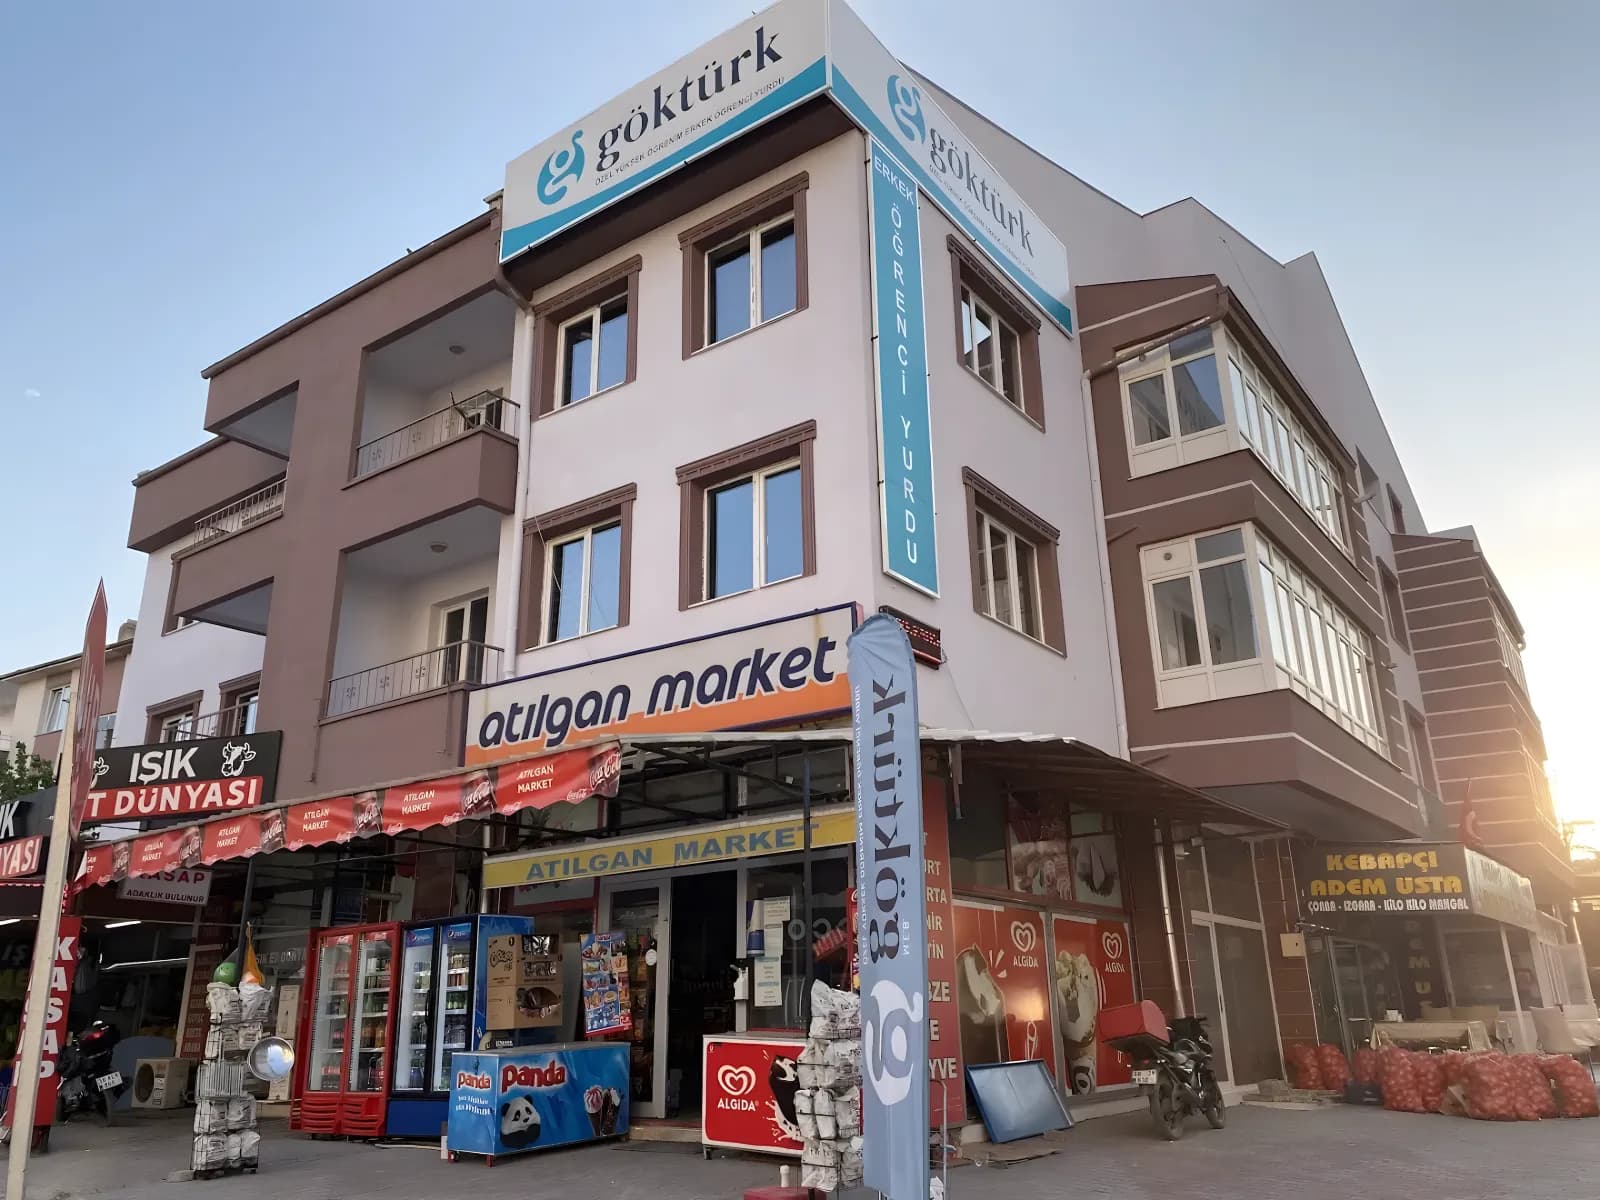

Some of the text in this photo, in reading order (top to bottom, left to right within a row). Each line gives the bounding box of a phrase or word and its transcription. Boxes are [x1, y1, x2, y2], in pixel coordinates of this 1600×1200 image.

[595, 26, 783, 172] göktürk
[684, 115, 713, 137] ERKEK
[753, 76, 785, 99] YURDU
[874, 154, 915, 206] ERKEK
[930, 128, 1034, 258] göktürk
[891, 202, 918, 565] ÖĞRENCİ YURDU
[478, 636, 836, 748] atılgan market
[129, 746, 200, 785] IŞIK
[516, 764, 554, 780] ATILGAN
[113, 779, 258, 816] DÜNYASI
[517, 778, 553, 794] MARKET
[401, 802, 432, 816] MARKET
[526, 823, 820, 881] ATILGAN MARKET
[1326, 851, 1439, 873] KEBAPÇI
[1310, 878, 1388, 897] ADEM
[1395, 875, 1463, 896] USTA
[717, 1097, 757, 1112] ALGIDA
